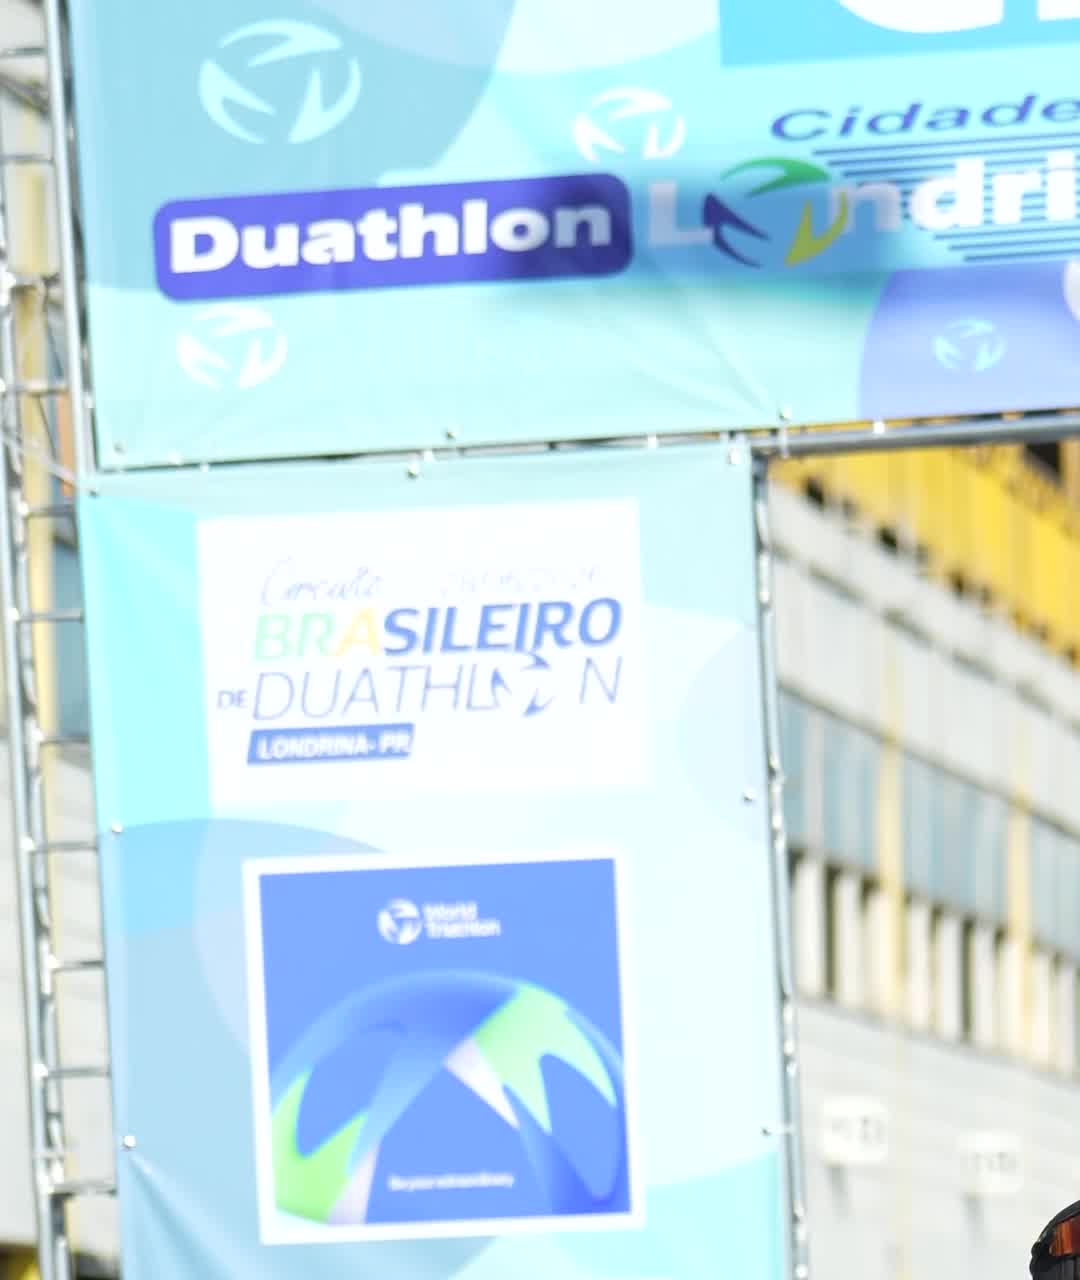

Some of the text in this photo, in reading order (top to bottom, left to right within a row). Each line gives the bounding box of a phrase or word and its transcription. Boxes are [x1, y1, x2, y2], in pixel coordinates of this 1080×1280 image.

[169, 199, 611, 274] Duathlon
[253, 597, 624, 661] BRASILEIRO
[217, 688, 248, 709] DE
